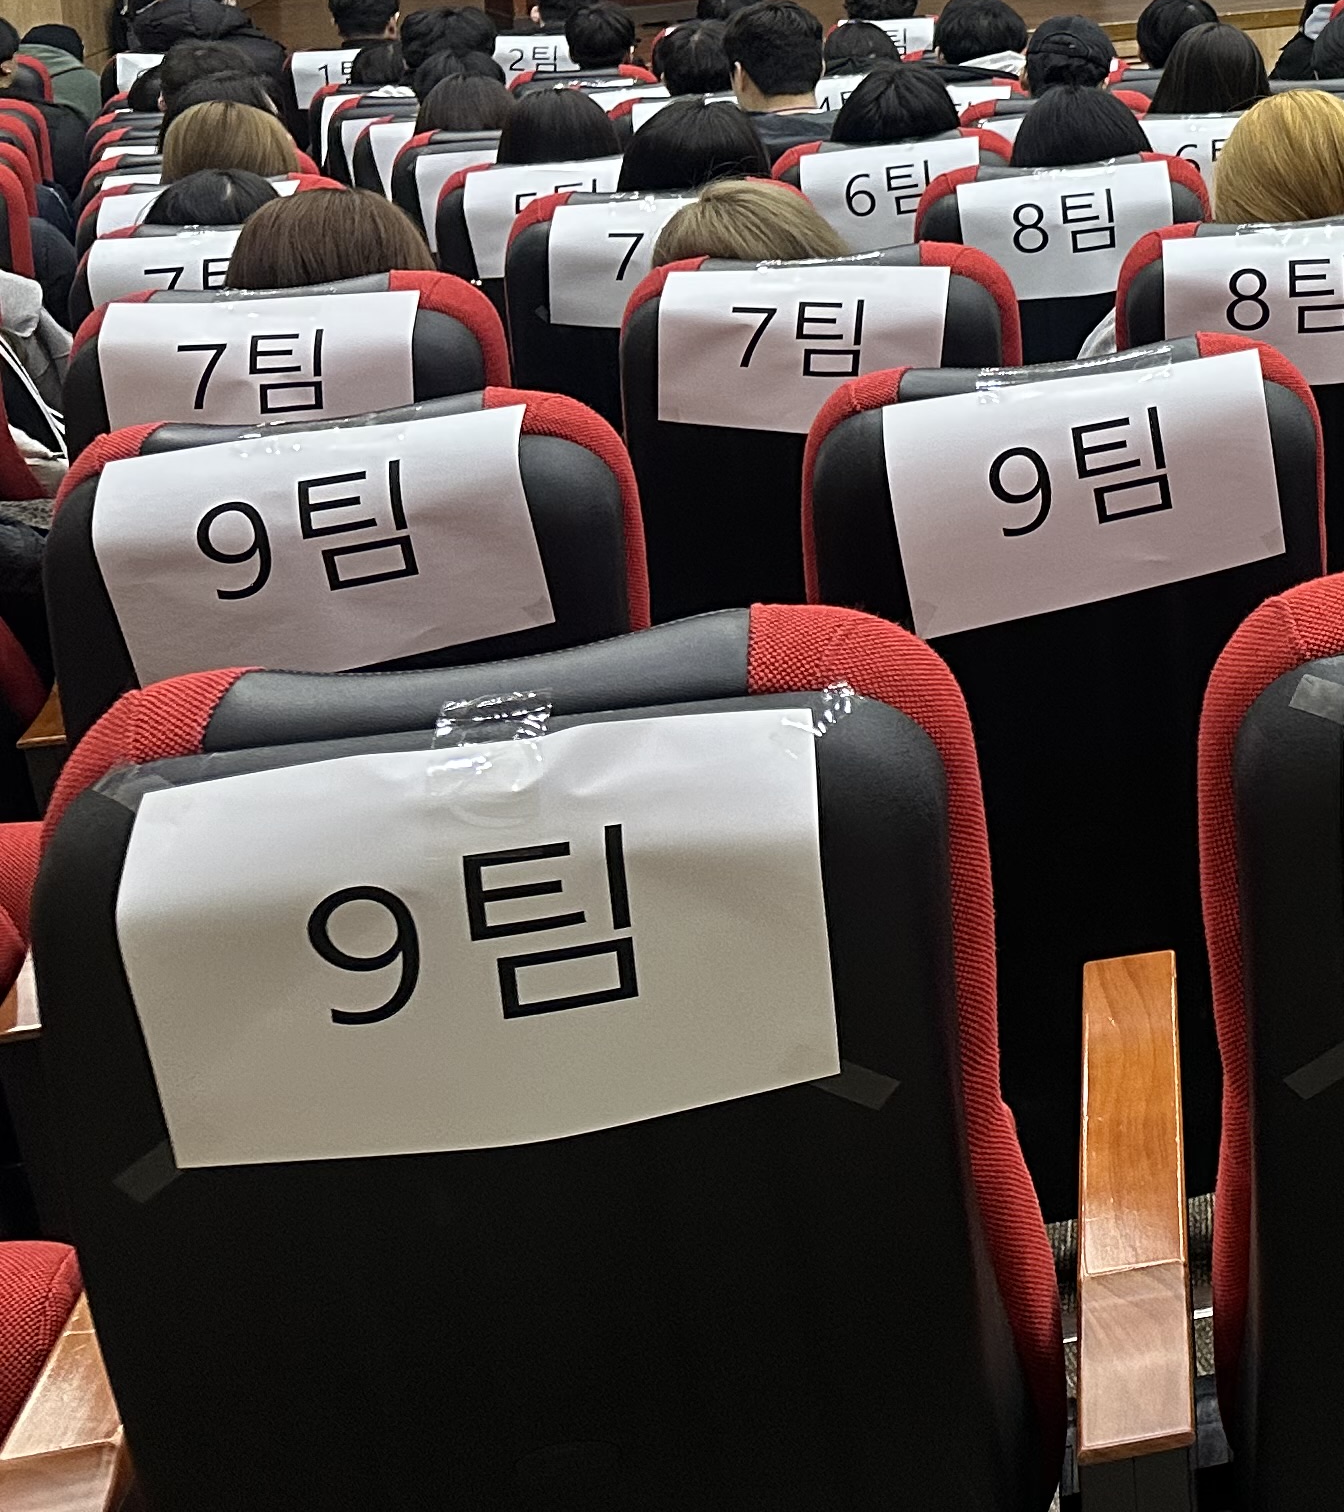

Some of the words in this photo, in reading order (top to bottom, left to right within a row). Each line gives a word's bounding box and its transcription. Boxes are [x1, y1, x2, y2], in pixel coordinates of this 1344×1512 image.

[845, 159, 931, 217] 6팀
[1012, 188, 1116, 254] 8팀
[177, 328, 324, 415] 7팀
[731, 299, 865, 378] 7팀
[988, 406, 1173, 538] 9팀
[196, 459, 420, 601] 9팀
[306, 823, 640, 1026] 9팀
